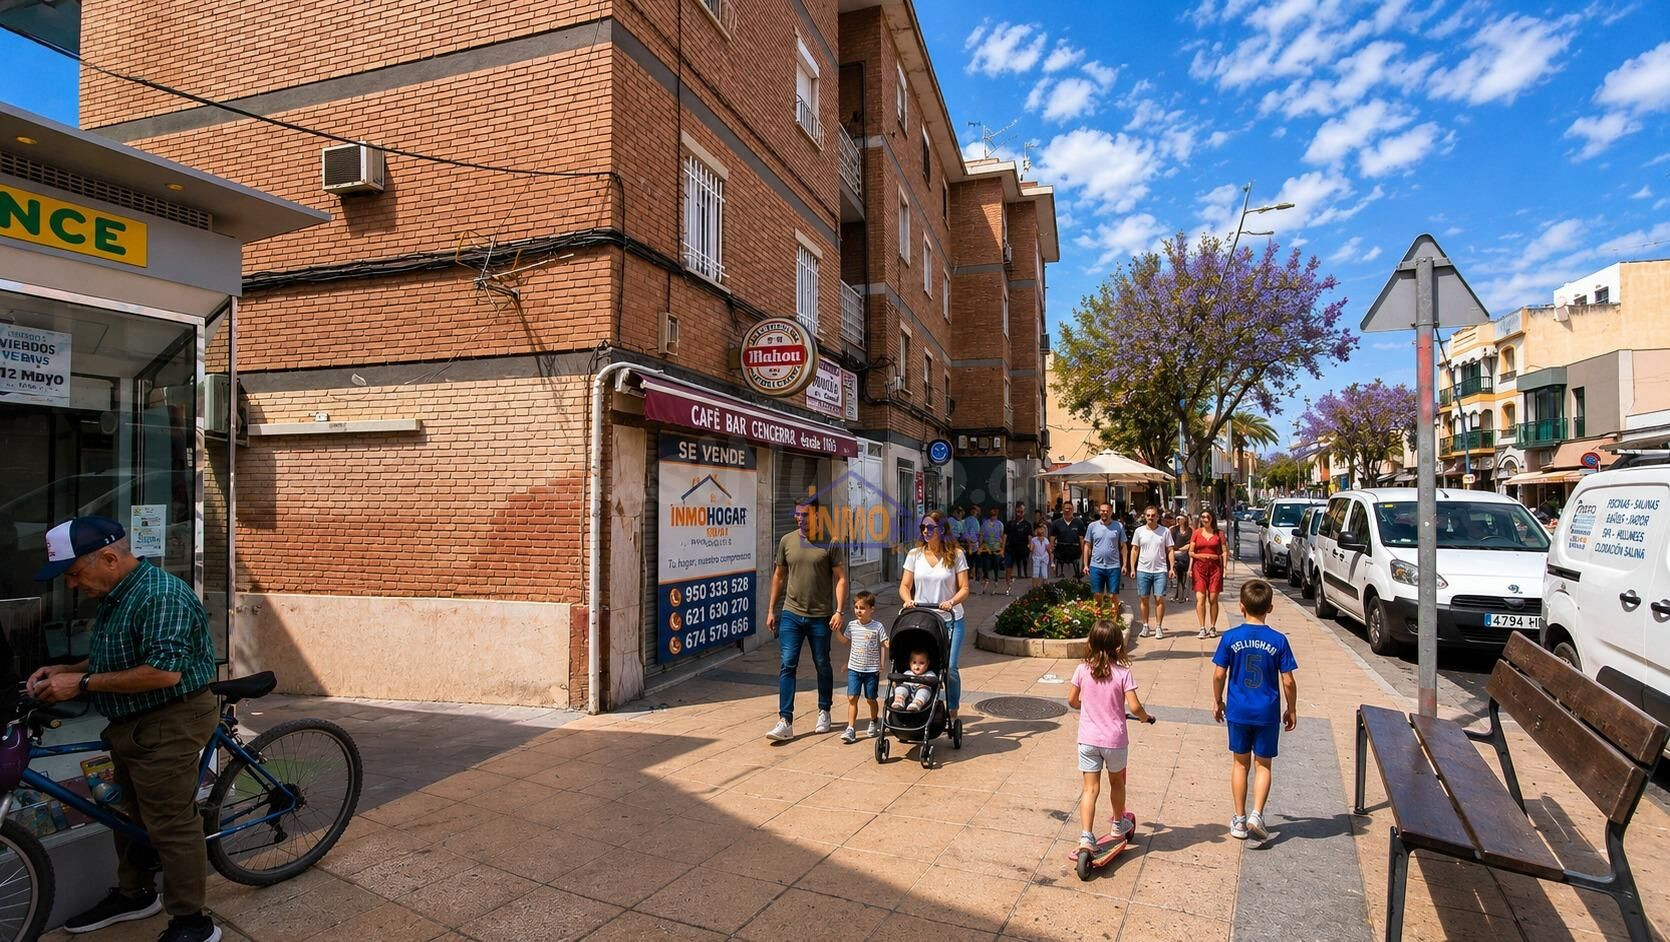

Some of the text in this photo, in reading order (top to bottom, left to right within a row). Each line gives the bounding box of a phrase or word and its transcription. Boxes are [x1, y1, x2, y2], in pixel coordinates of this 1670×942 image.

[748, 349, 802, 364] Mahou
[726, 413, 747, 436] BAR
[679, 441, 745, 466] SE VENDE
[686, 577, 749, 603] 950 333 528
[686, 597, 749, 626] 621 630 270
[1493, 615, 1523, 627] 4794
[686, 629, 706, 649] 674
[710, 622, 729, 642] 579
[1244, 653, 1264, 688] 5
